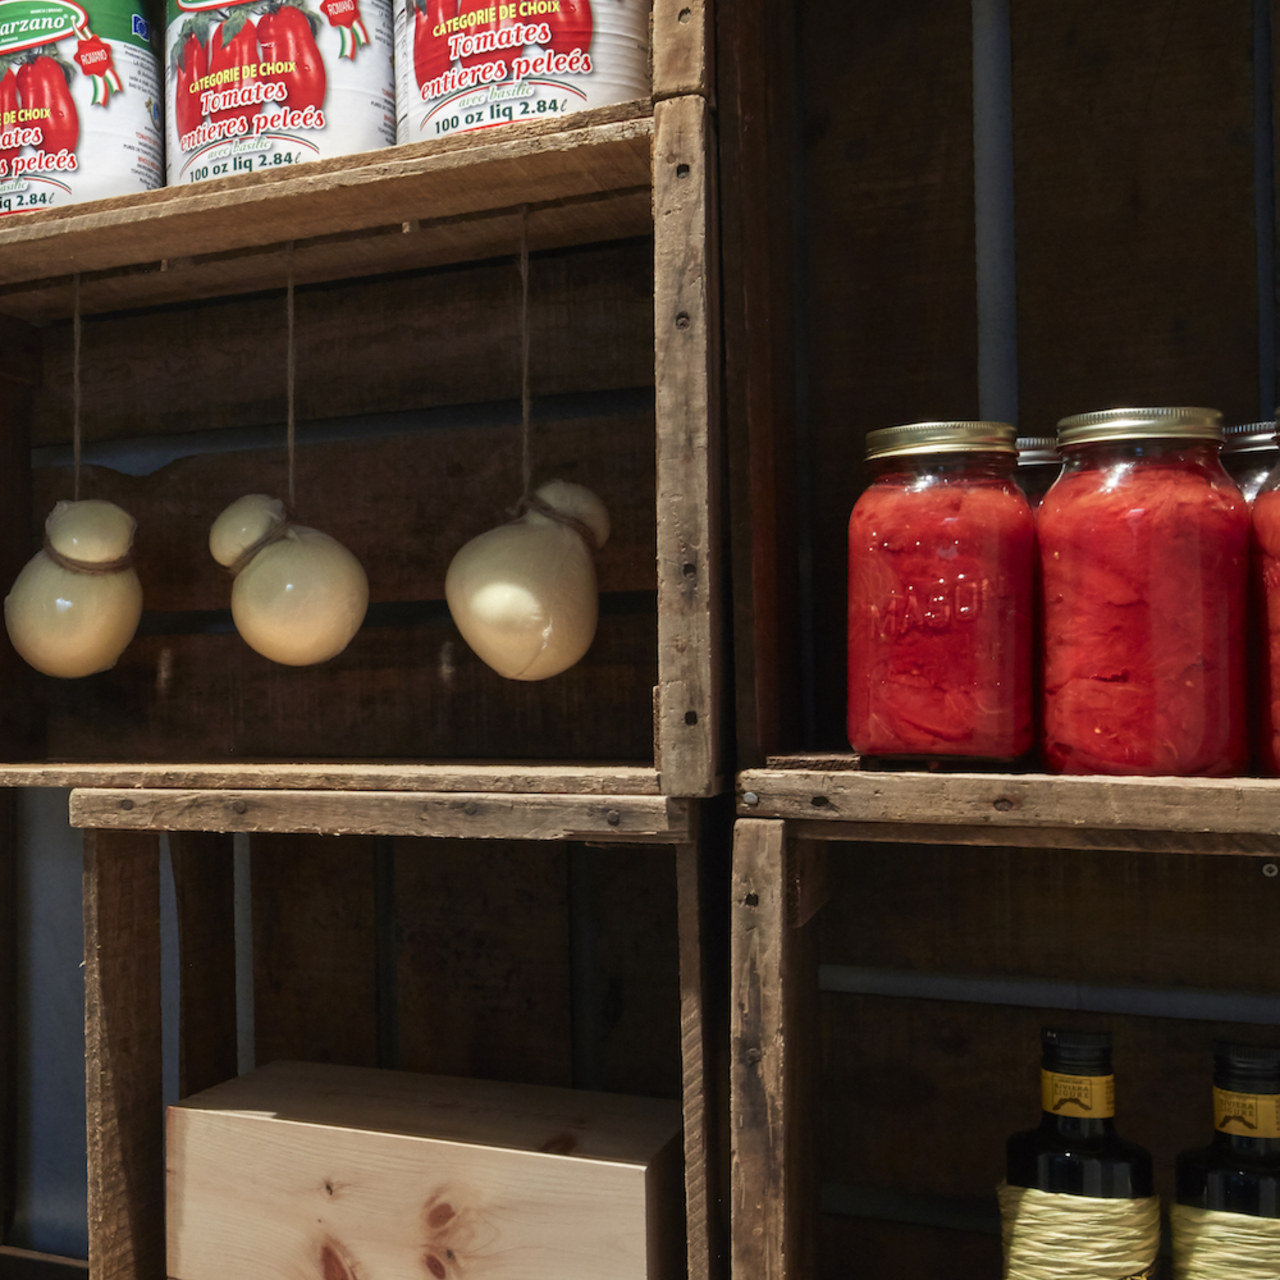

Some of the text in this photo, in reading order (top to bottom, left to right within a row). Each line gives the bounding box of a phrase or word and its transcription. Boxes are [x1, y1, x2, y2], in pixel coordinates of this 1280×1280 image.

[432, 0, 560, 37] CATEGORIE DE CHOIX
[448, 23, 551, 60] Tomates
[189, 61, 296, 94] CATEGORIE DE CHOIX
[420, 48, 592, 101] entieres peleés
[201, 82, 287, 115] Tomates
[458, 83, 534, 108] avec basilic
[3, 111, 16, 124] DE
[17, 108, 51, 122] CHOIX
[180, 106, 325, 152] entieres peleés
[435, 116, 460, 134] 100
[465, 110, 484, 124] oz
[490, 104, 514, 121] liq
[233, 138, 270, 154] basilic
[12, 149, 77, 176] peleés
[190, 165, 208, 182] 100
[213, 162, 228, 175] oz
[233, 156, 253, 171] liq
